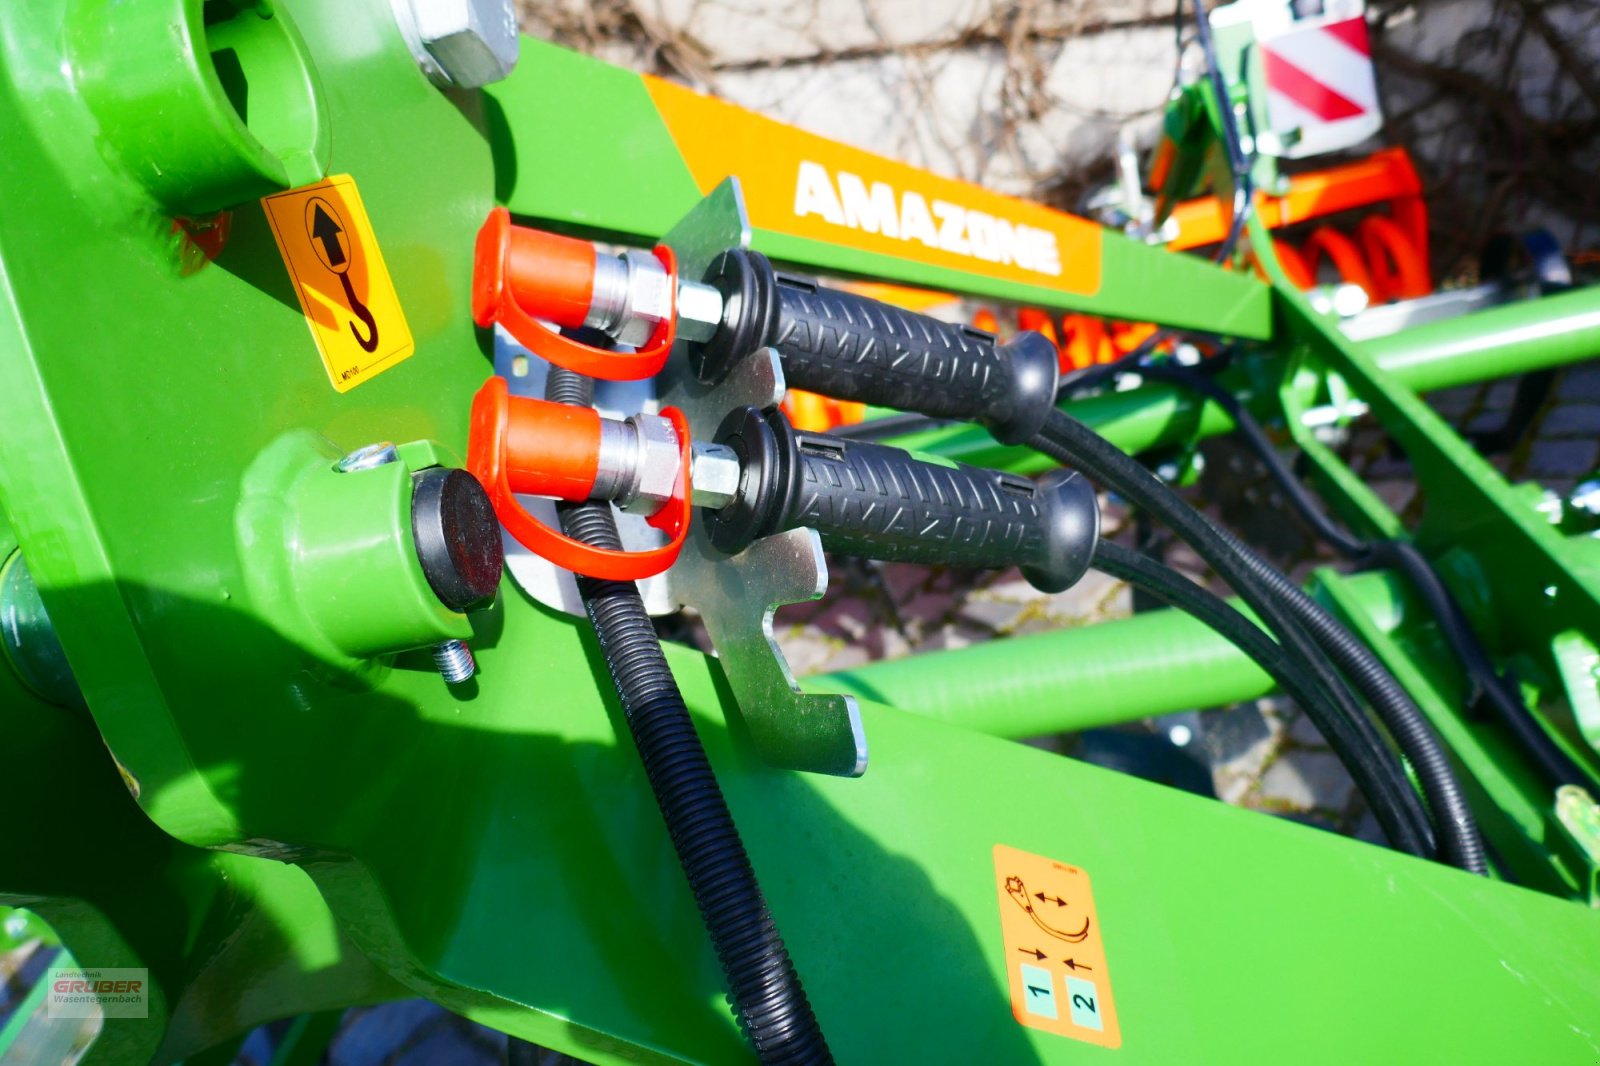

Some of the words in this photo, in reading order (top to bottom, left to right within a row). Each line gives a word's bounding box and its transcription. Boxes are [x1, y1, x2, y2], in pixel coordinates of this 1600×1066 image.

[794, 160, 1062, 276] AMAZONE
[1027, 984, 1050, 998] 1
[1072, 993, 1096, 1013] 2
